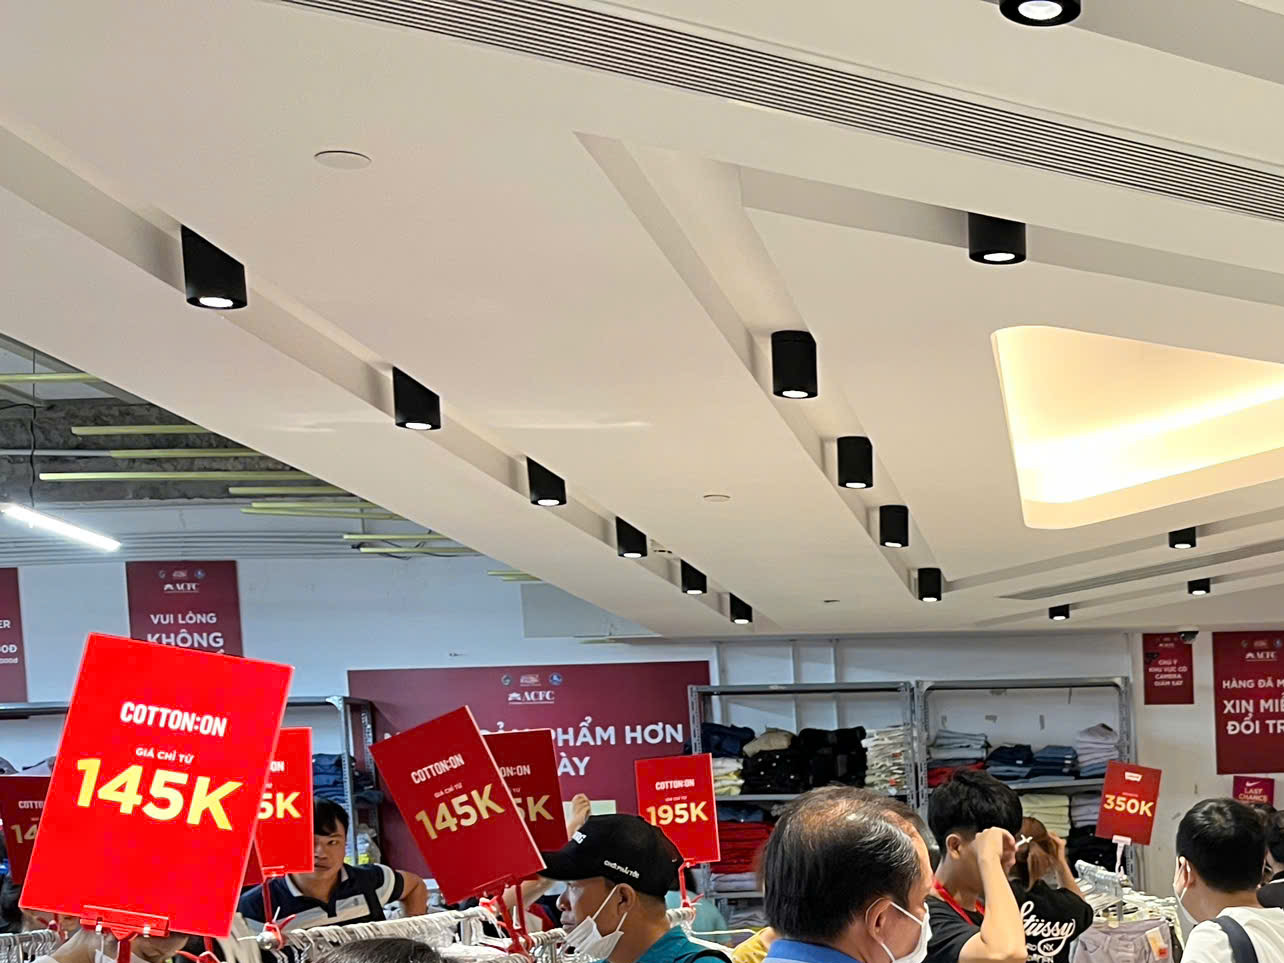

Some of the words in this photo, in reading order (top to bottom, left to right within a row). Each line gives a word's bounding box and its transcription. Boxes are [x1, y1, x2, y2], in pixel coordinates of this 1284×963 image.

[150, 614, 174, 624] VUI
[178, 611, 217, 624] LÒNG
[147, 629, 224, 648] KHÔNG
[1222, 677, 1255, 688] HÀNG
[1257, 676, 1273, 688] ĐÃ
[522, 690, 555, 701] ACFC
[1223, 699, 1254, 714] XIN
[120, 702, 228, 737] COTTON:ON
[551, 716, 616, 747] HẨM
[625, 722, 684, 745] HƠN
[1226, 713, 1260, 735] ĐỔI
[135, 747, 155, 759] GIÁ
[157, 749, 177, 762] CHỈ
[178, 753, 195, 765] TỪ
[557, 752, 591, 777] ÀY
[411, 753, 465, 784] COTTON:ON
[77, 758, 243, 831] 145K
[258, 792, 301, 820] 5K
[1103, 794, 1154, 817] 350K
[415, 783, 505, 840] 145K
[513, 794, 554, 822] 5K
[646, 801, 709, 826] 195K
[10, 824, 38, 844] 14
